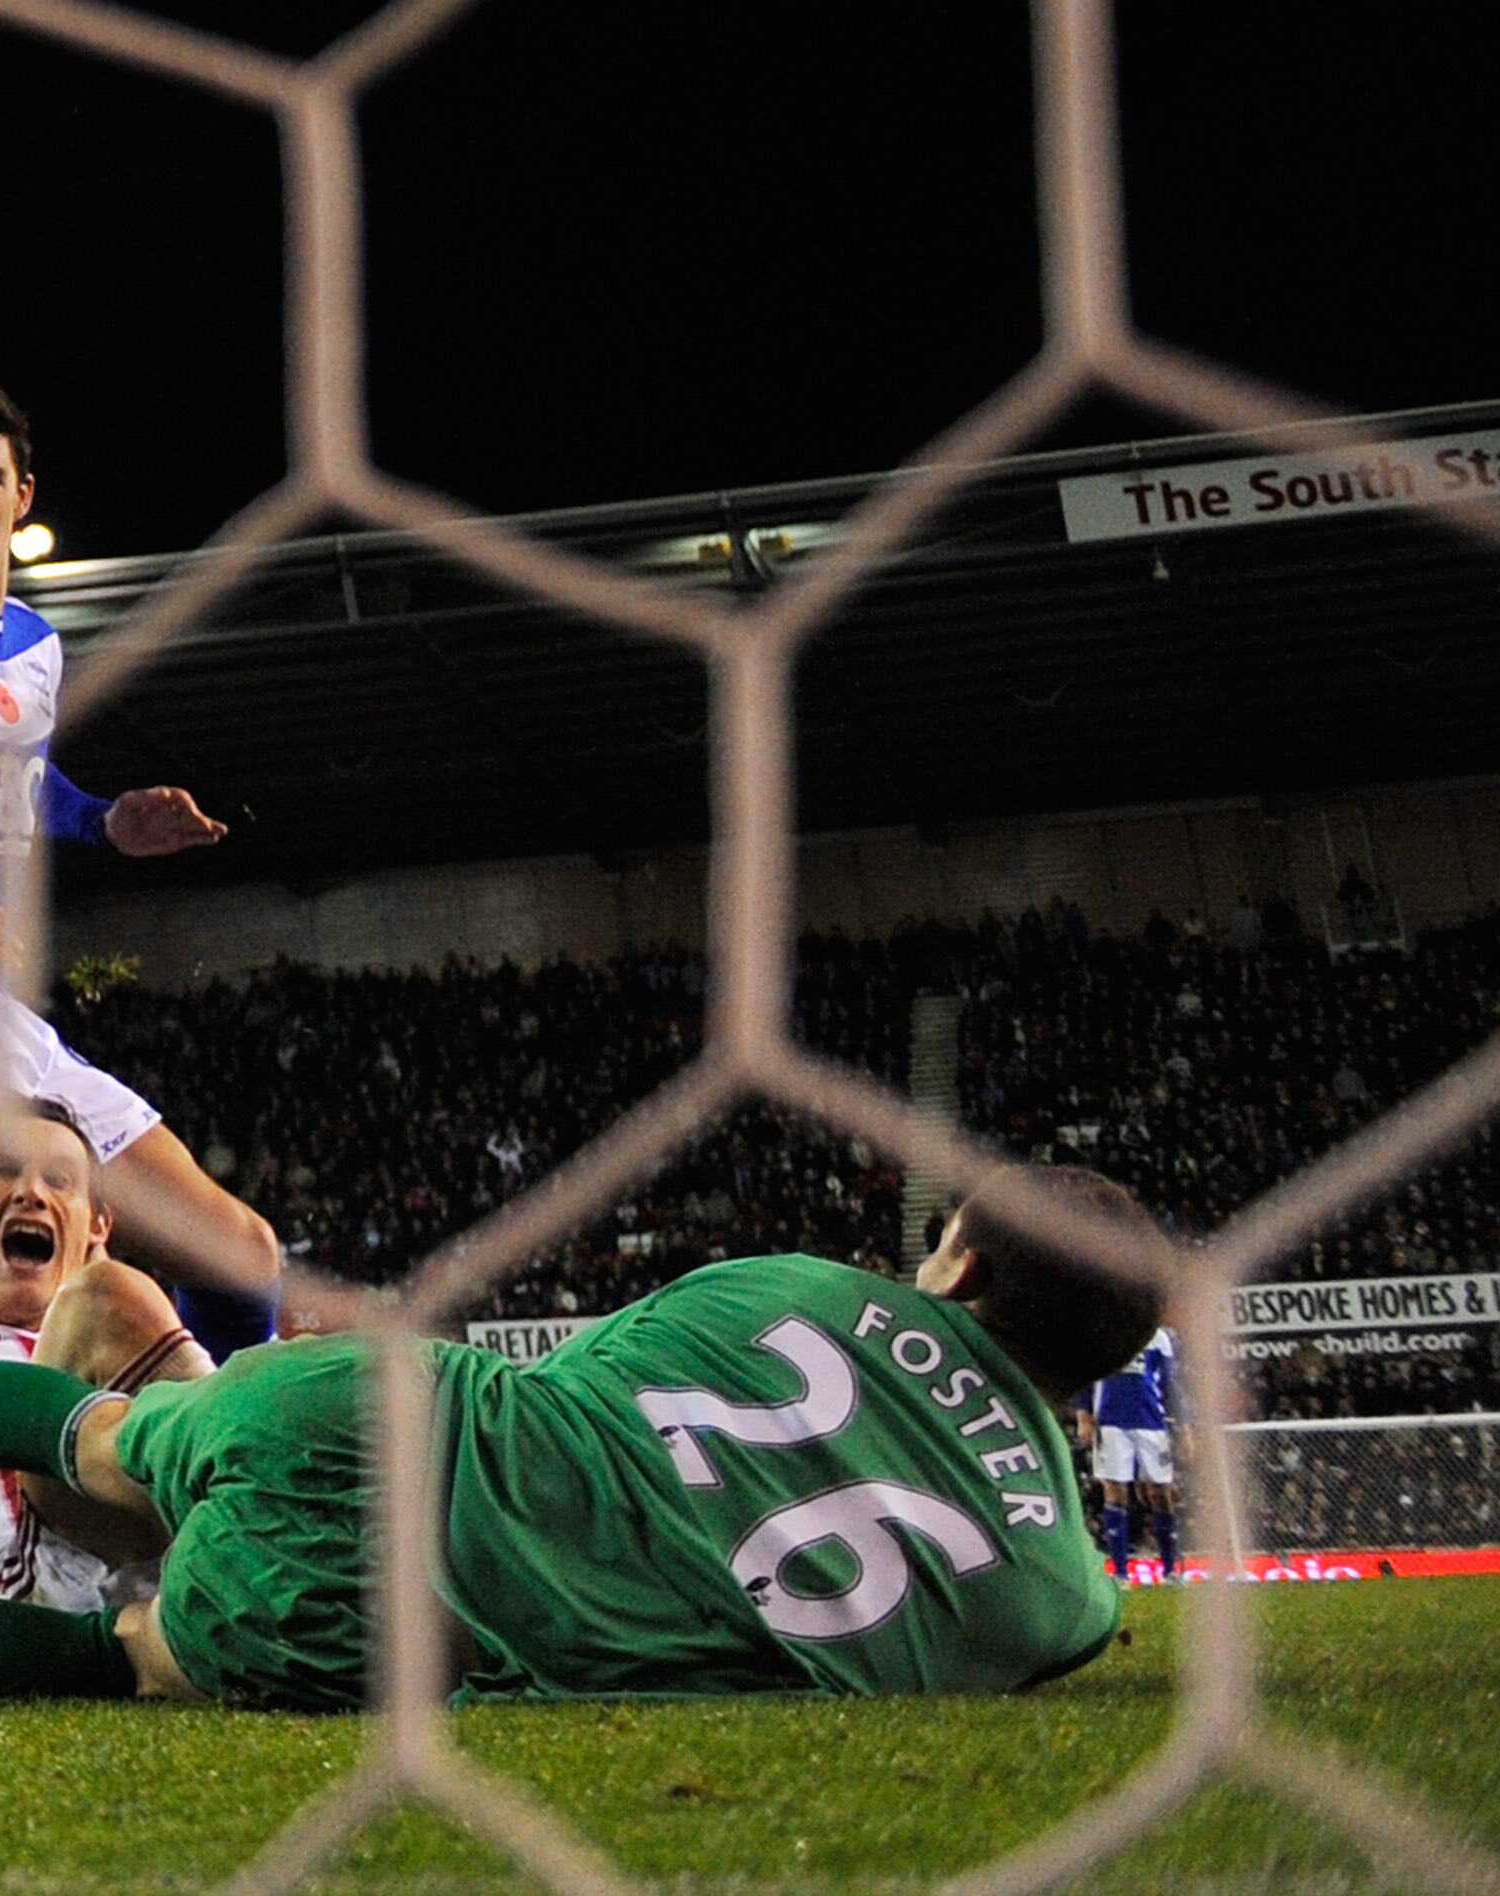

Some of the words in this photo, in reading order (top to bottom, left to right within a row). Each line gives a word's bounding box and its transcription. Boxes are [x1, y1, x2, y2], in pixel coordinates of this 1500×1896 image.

[1123, 479, 1231, 525] The
[1248, 457, 1416, 512] South
[1433, 446, 1500, 490] St
[1231, 1287, 1352, 1326] BESPOKE
[1357, 1281, 1458, 1319] HOMES
[1463, 1279, 1487, 1316] &
[634, 1313, 999, 1640] 26
[852, 1300, 1057, 1530] FOSTER
